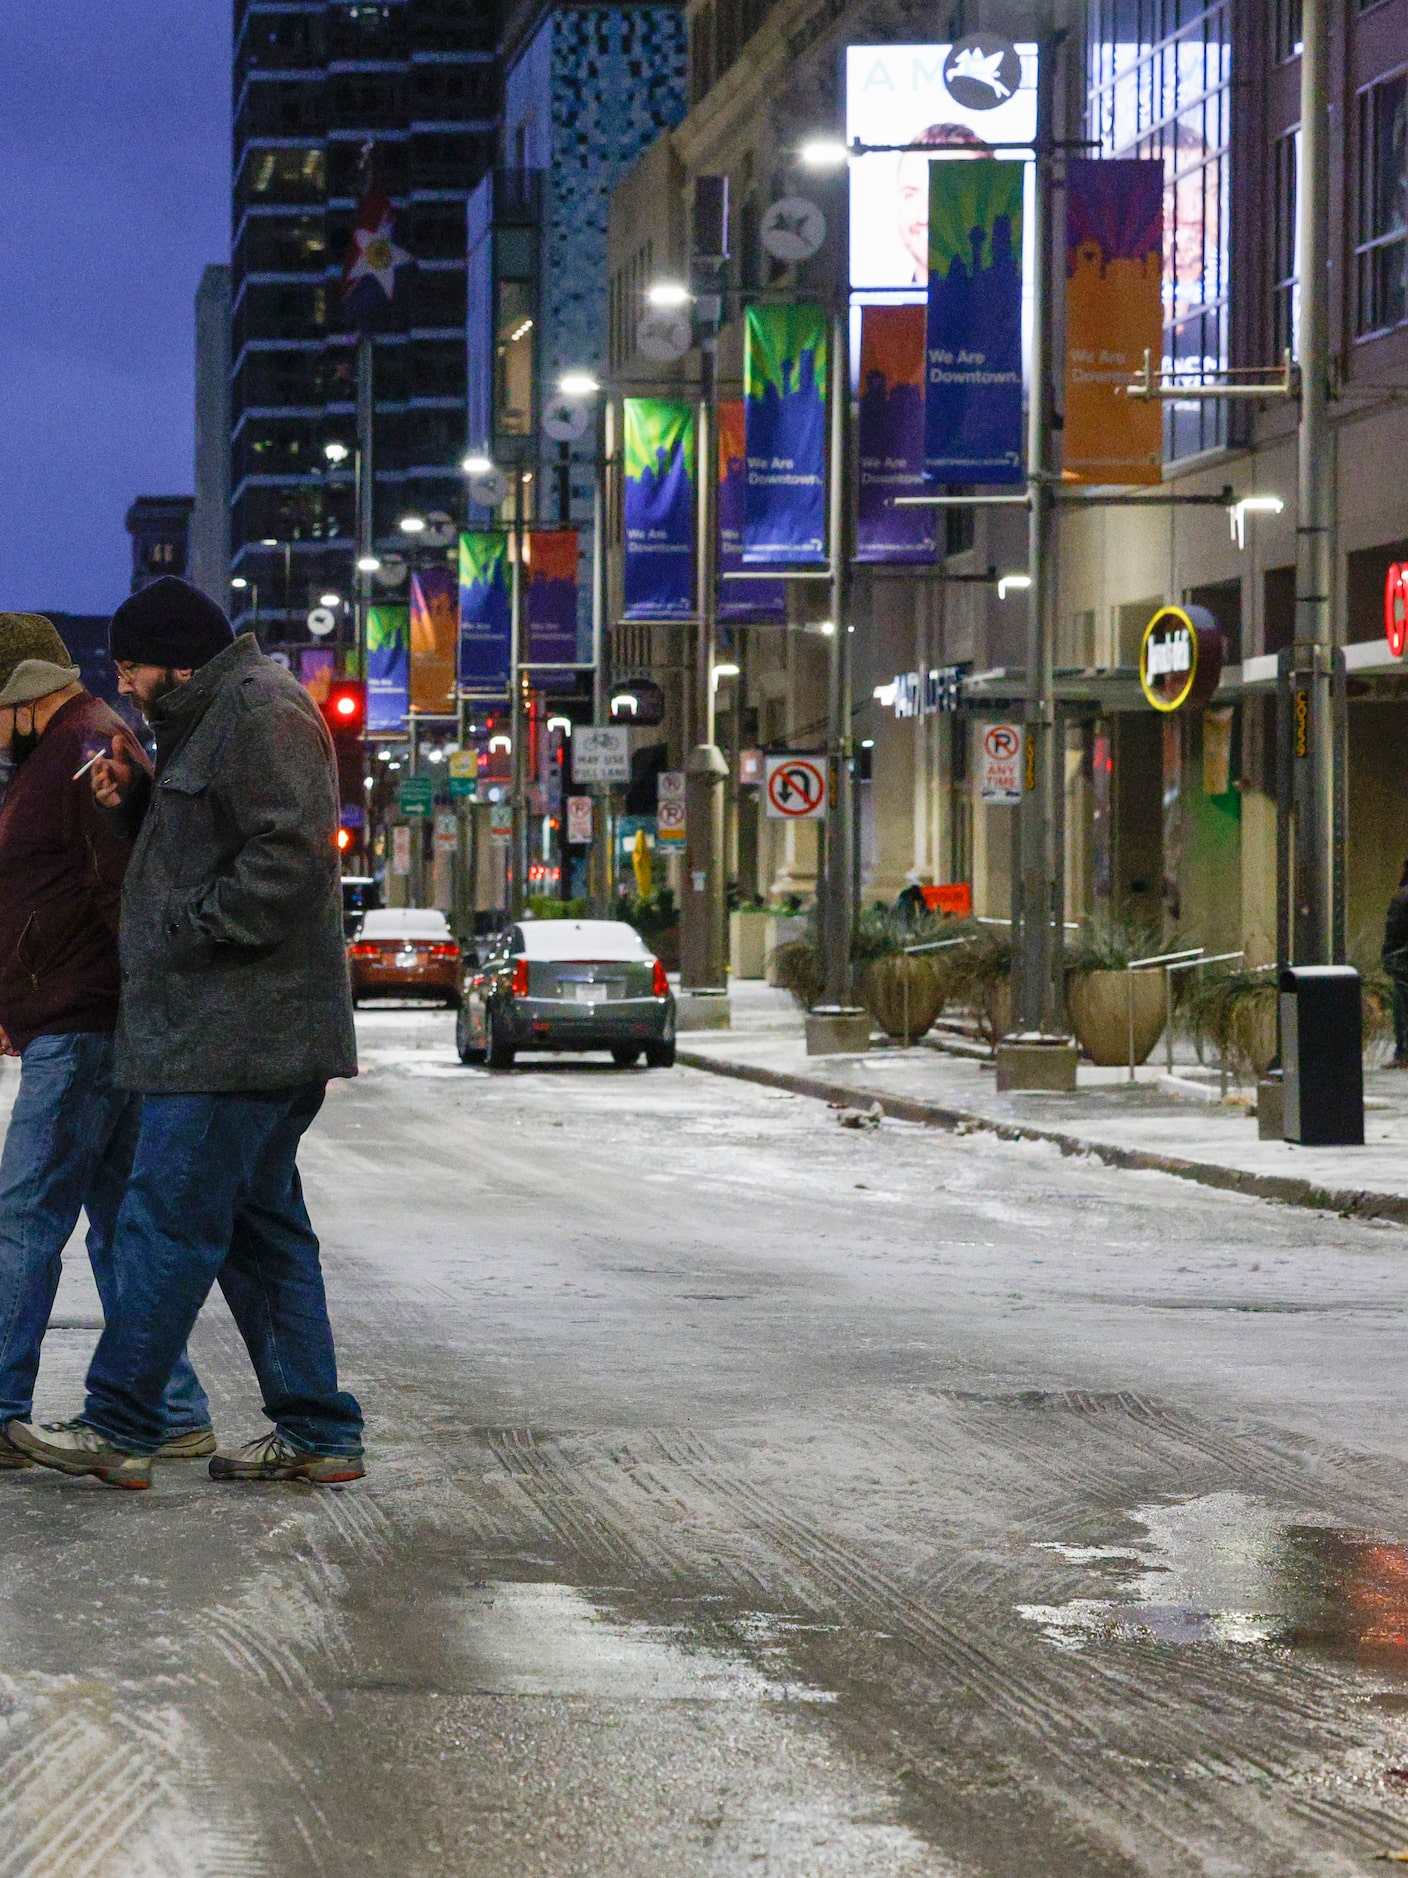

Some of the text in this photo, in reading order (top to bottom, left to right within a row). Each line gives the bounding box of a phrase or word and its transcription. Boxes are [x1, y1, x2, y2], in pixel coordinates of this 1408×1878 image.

[928, 350, 985, 365] We Are
[988, 765, 1015, 775] ANY
